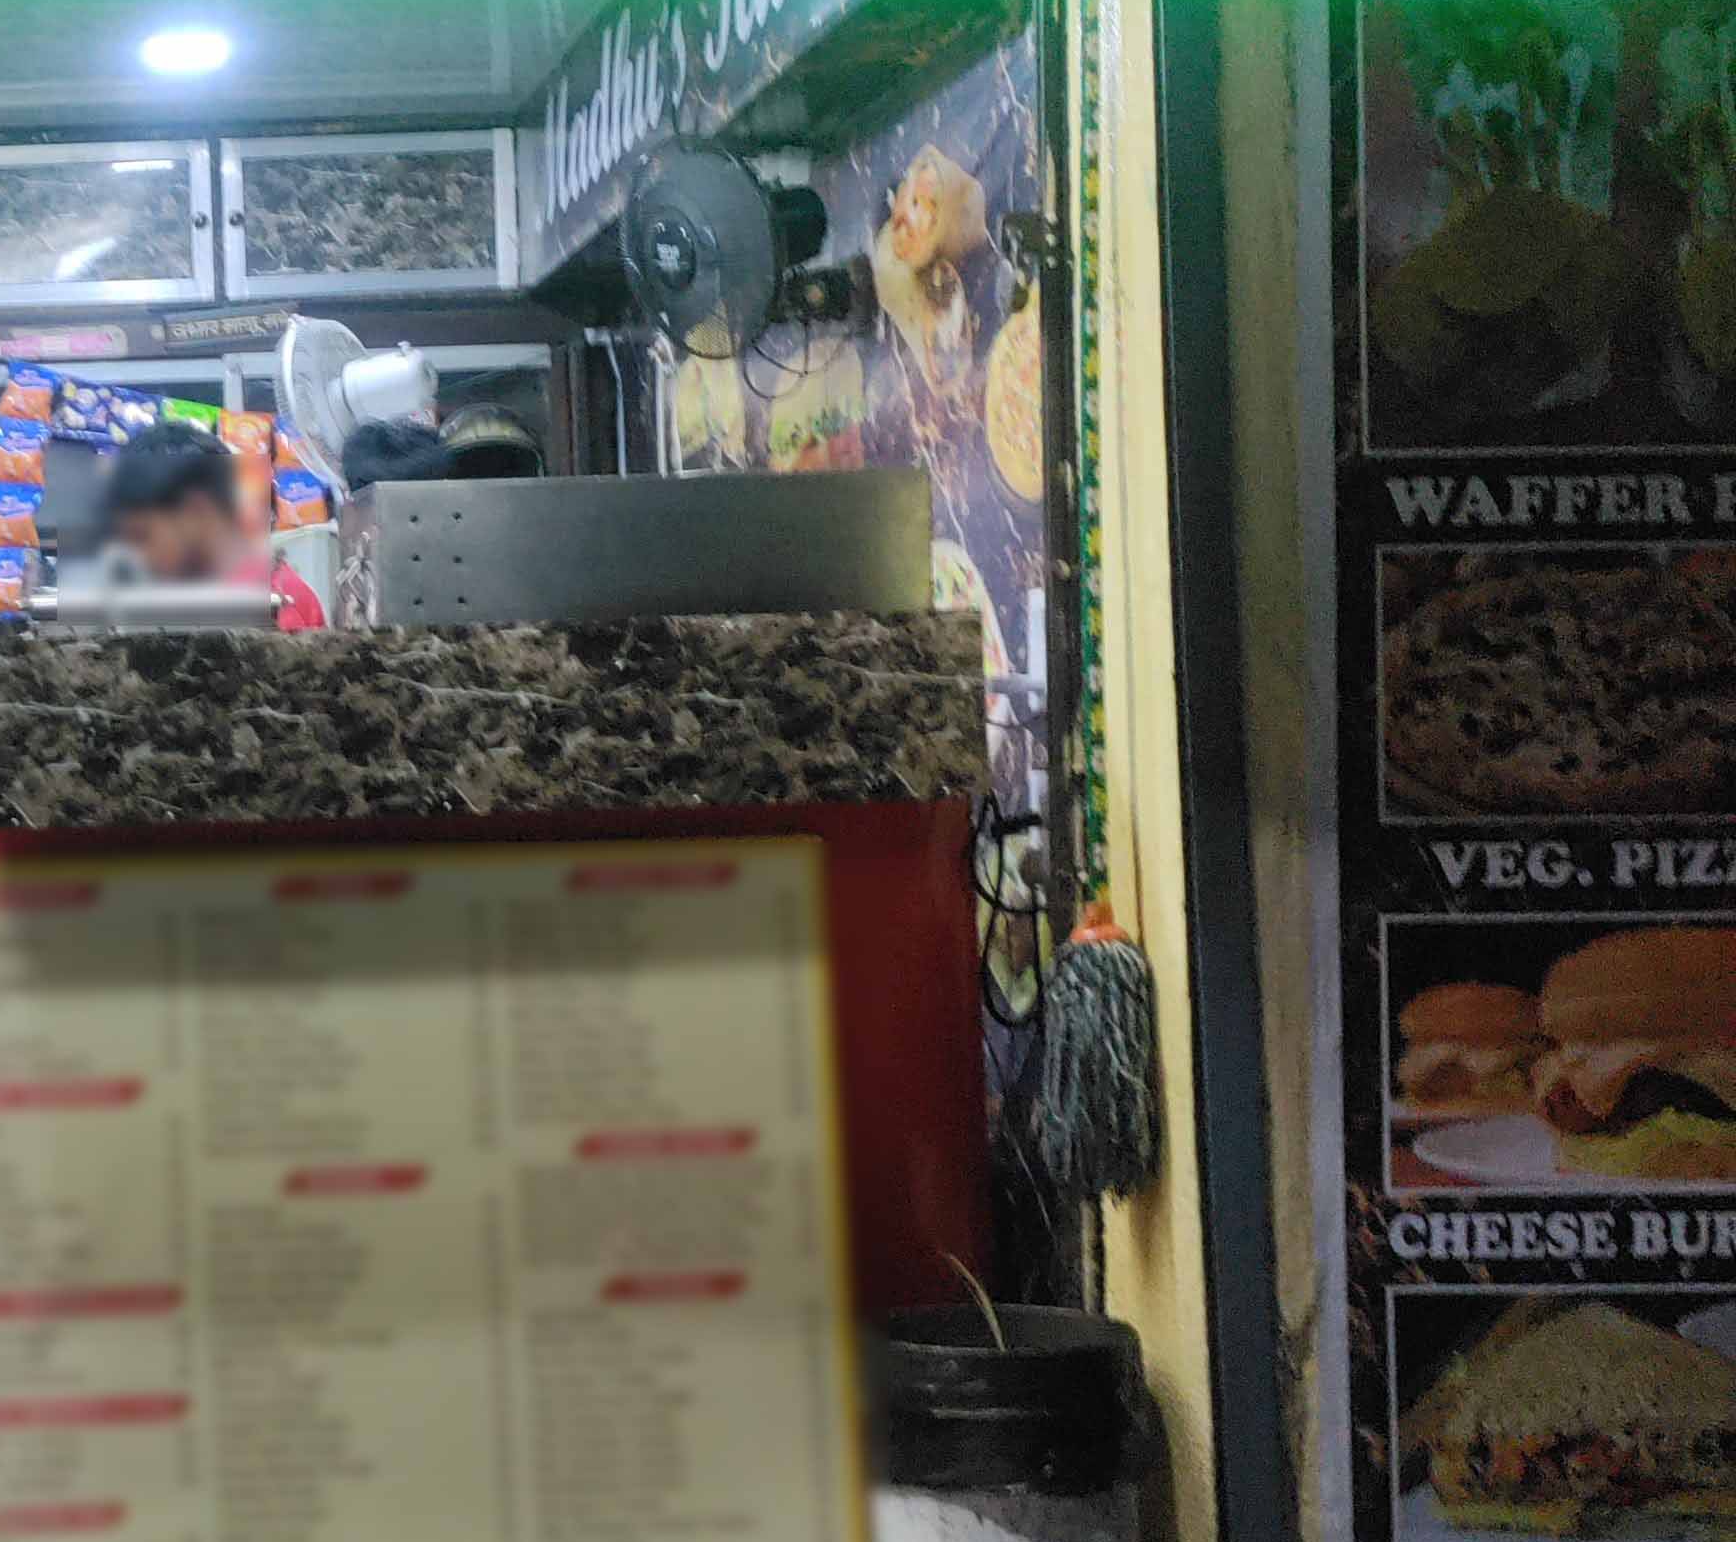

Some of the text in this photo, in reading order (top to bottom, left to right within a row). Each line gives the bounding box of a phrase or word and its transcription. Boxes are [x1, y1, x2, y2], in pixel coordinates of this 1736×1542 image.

[1385, 475, 1694, 526] WAFFER
[1431, 840, 1736, 889] VEG. PIZ
[1389, 1211, 1618, 1259] CHEESE
